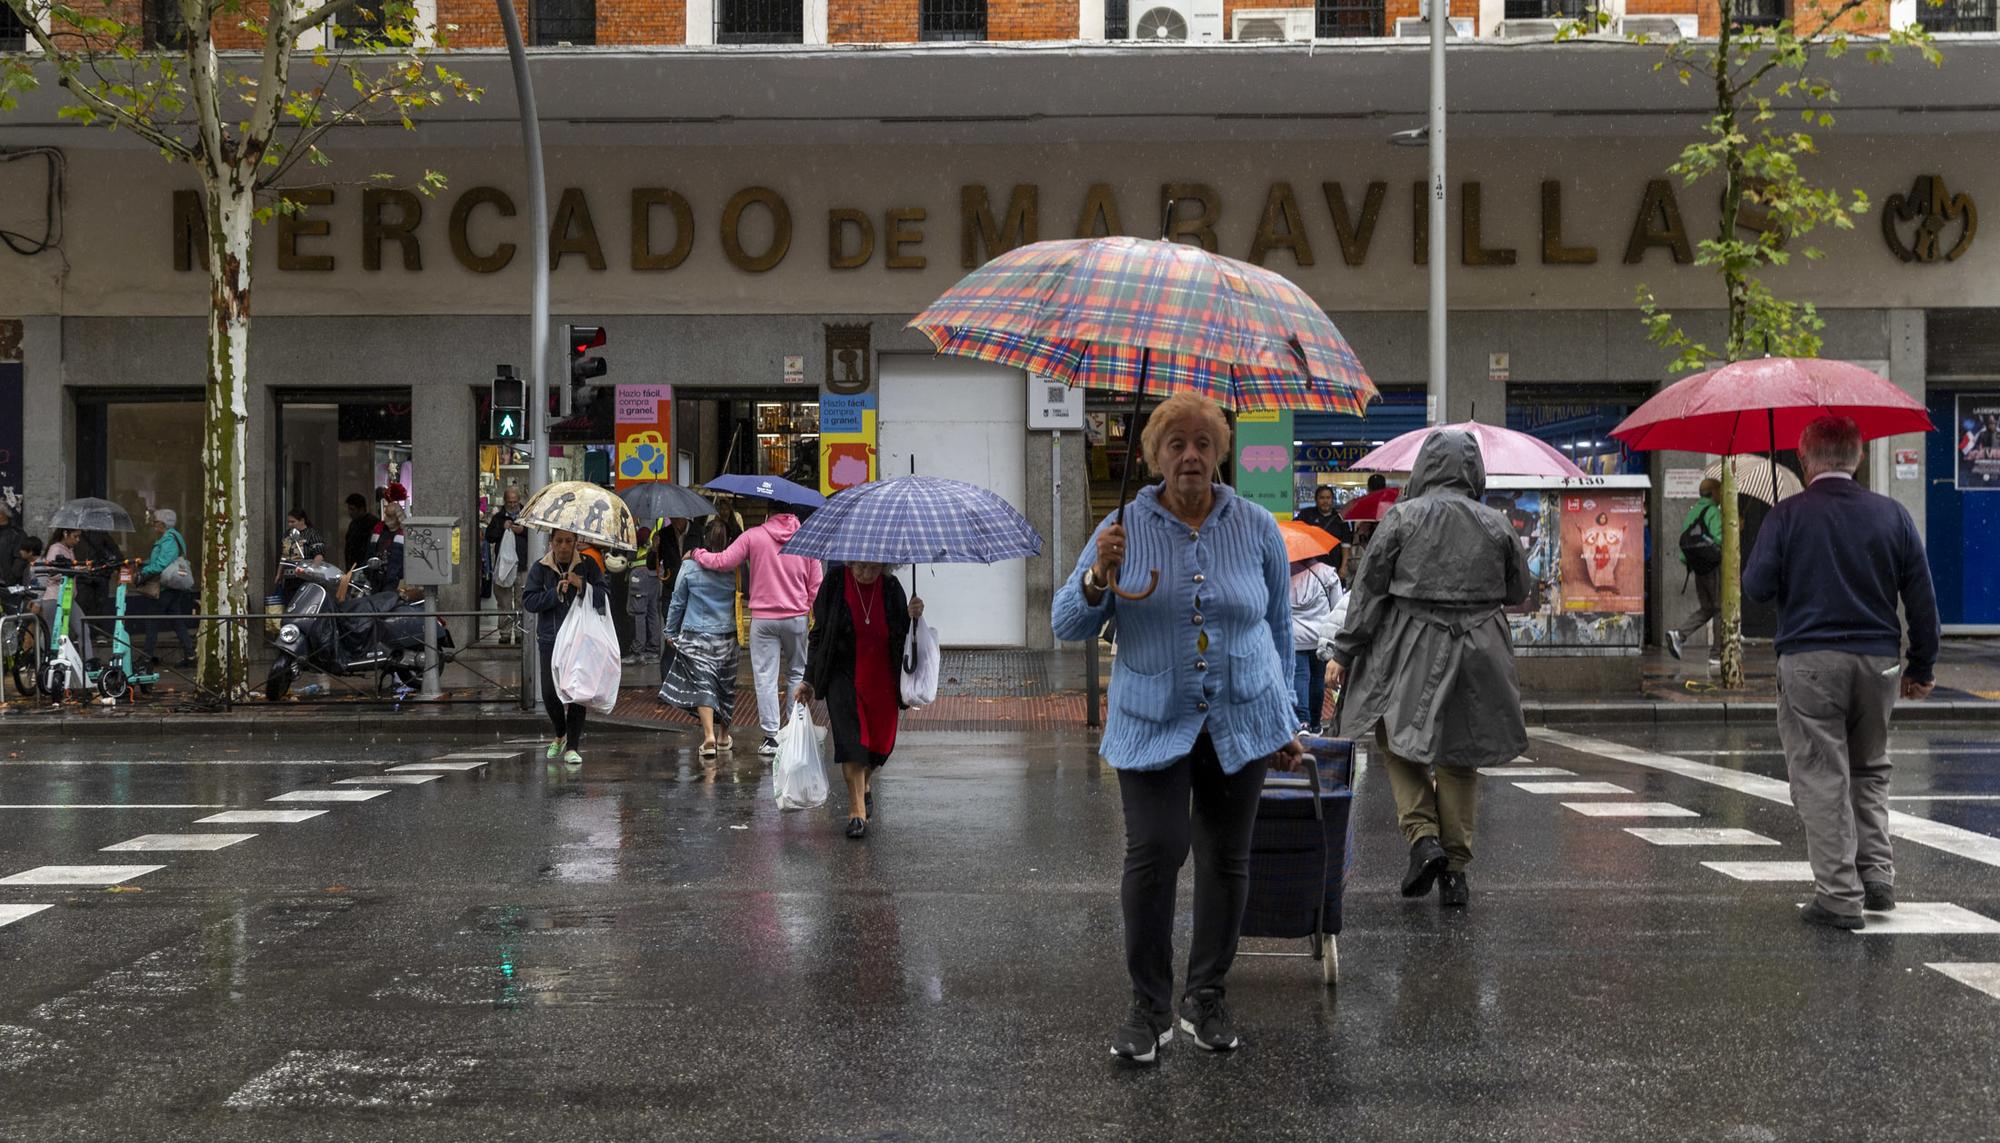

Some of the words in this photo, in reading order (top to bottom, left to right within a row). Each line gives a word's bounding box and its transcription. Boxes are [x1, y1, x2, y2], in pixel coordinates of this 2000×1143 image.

[827, 207, 927, 270] DE
[618, 389, 641, 398] Hazlo
[618, 399, 650, 407] compra
[823, 399, 846, 408] Hazlo
[626, 407, 655, 416] granel.
[823, 408, 854, 417] compra
[823, 417, 829, 425] a
